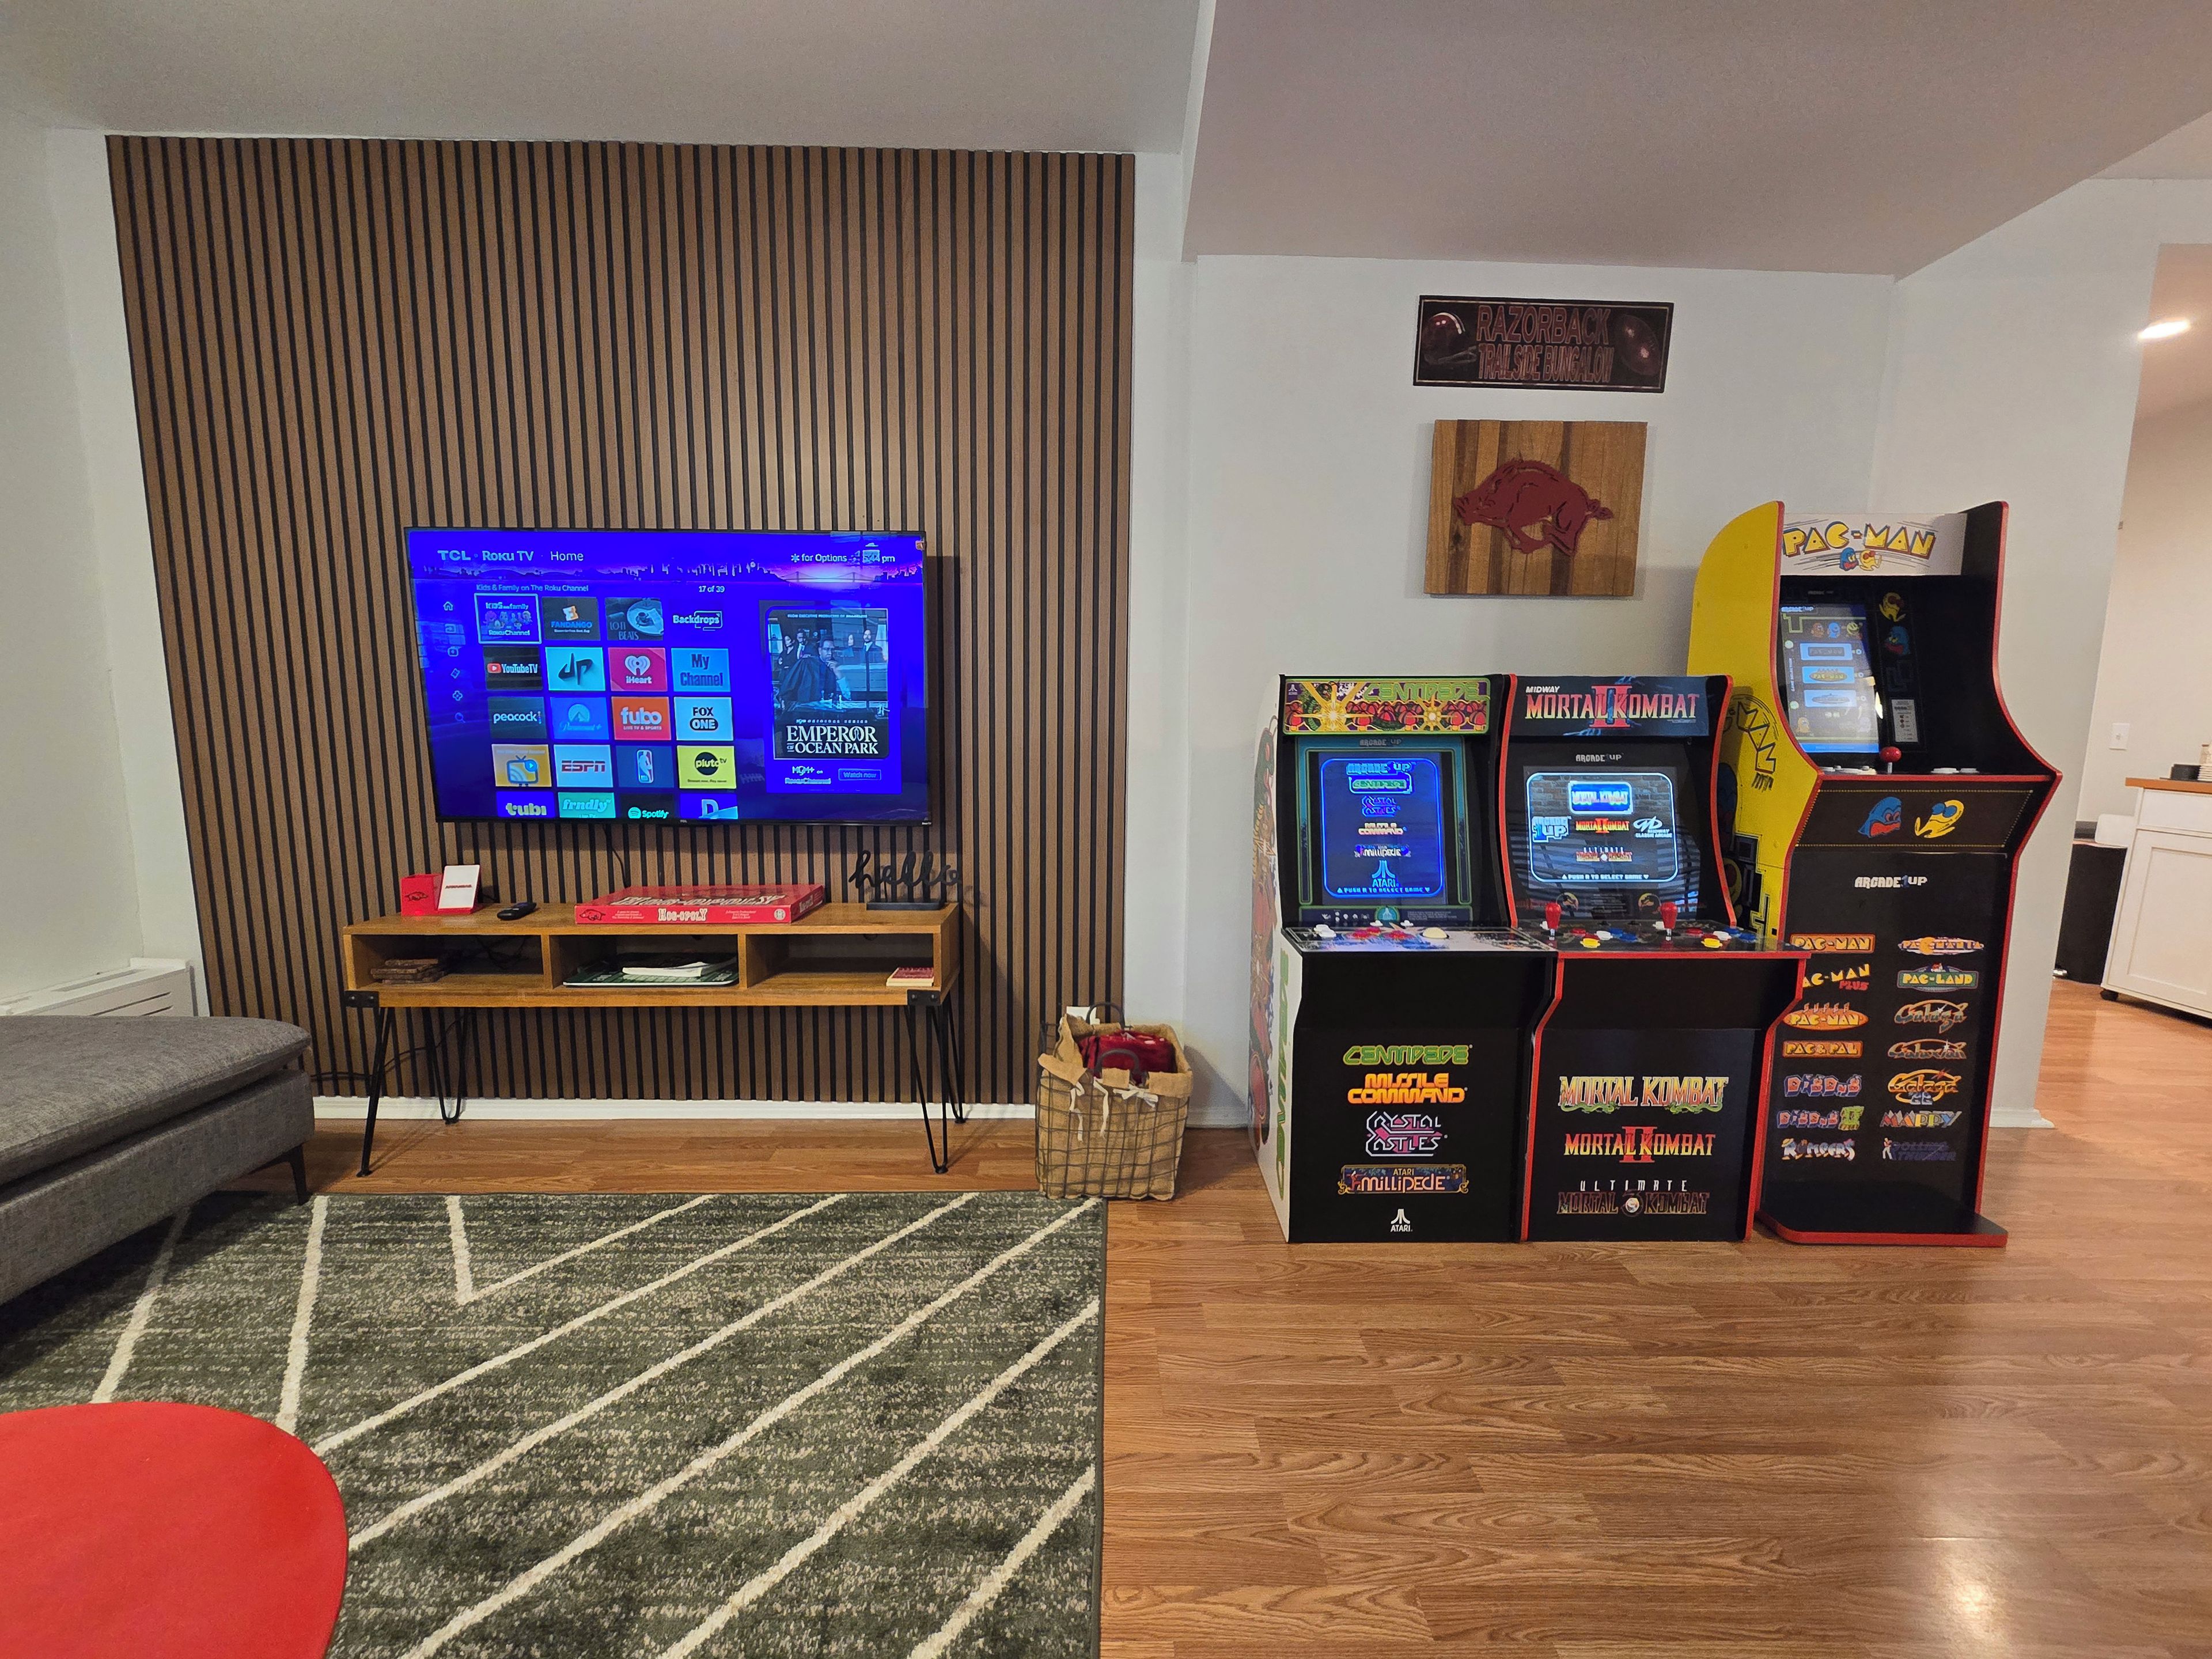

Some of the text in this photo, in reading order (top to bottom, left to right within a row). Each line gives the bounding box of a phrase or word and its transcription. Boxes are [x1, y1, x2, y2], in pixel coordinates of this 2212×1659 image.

[1476, 305, 1611, 344] RAZORBACK
[1543, 346, 1614, 382] BUNGALOW
[1783, 521, 1936, 559] PAC-MAN
[438, 550, 584, 561] TCL Roku TV Home
[801, 554, 847, 563] for Options
[673, 614, 719, 625] Backdrops
[691, 653, 709, 669] My
[626, 676, 652, 684] iHeart
[680, 672, 723, 687] Channel
[1363, 682, 1483, 700] CENTIPEDE
[693, 707, 713, 716] FOX
[1525, 694, 1608, 719] MORTAL
[1612, 694, 1700, 719] KOMBAT
[493, 711, 537, 724] peacock
[620, 706, 662, 725] fubo
[692, 719, 715, 729] ONE
[786, 725, 878, 742] EMPEROR
[795, 743, 842, 753] OCEAN
[844, 743, 878, 753] PARK
[561, 760, 605, 772] ESPN
[695, 759, 719, 768] pluto
[506, 803, 547, 816] tubi
[642, 809, 668, 819] Spotify
[848, 850, 960, 888] hello
[1372, 878, 1396, 887] ATARI
[1854, 875, 1927, 889] ARCADE1UP
[1793, 937, 1872, 950] PAC-MAN
[1803, 964, 1870, 988] AC-MAN
[1903, 974, 1973, 984] PAC-LAND
[1839, 980, 1869, 991] PLUS
[1790, 1014, 1861, 1026] PAC-MAN
[1343, 1045, 1470, 1065] CENTIPEDE
[1786, 1043, 1858, 1055] PAC & PAL
[1365, 1073, 1449, 1088] MISSILE
[1347, 1087, 1465, 1104] COMMAND
[1558, 1076, 1729, 1107] MORTAL KOMBAT
[1366, 1111, 1441, 1134] CRYSTAL
[1880, 1110, 1962, 1128] MAPPY
[1366, 1132, 1441, 1156] CASTLES
[1564, 1134, 1636, 1156] MORTAL
[1639, 1134, 1716, 1156] KOMBAT
[1580, 1180, 1687, 1191] ULTIMATE
[1557, 1192, 1618, 1214] MORTAL
[1644, 1192, 1710, 1214] KOMBAT
